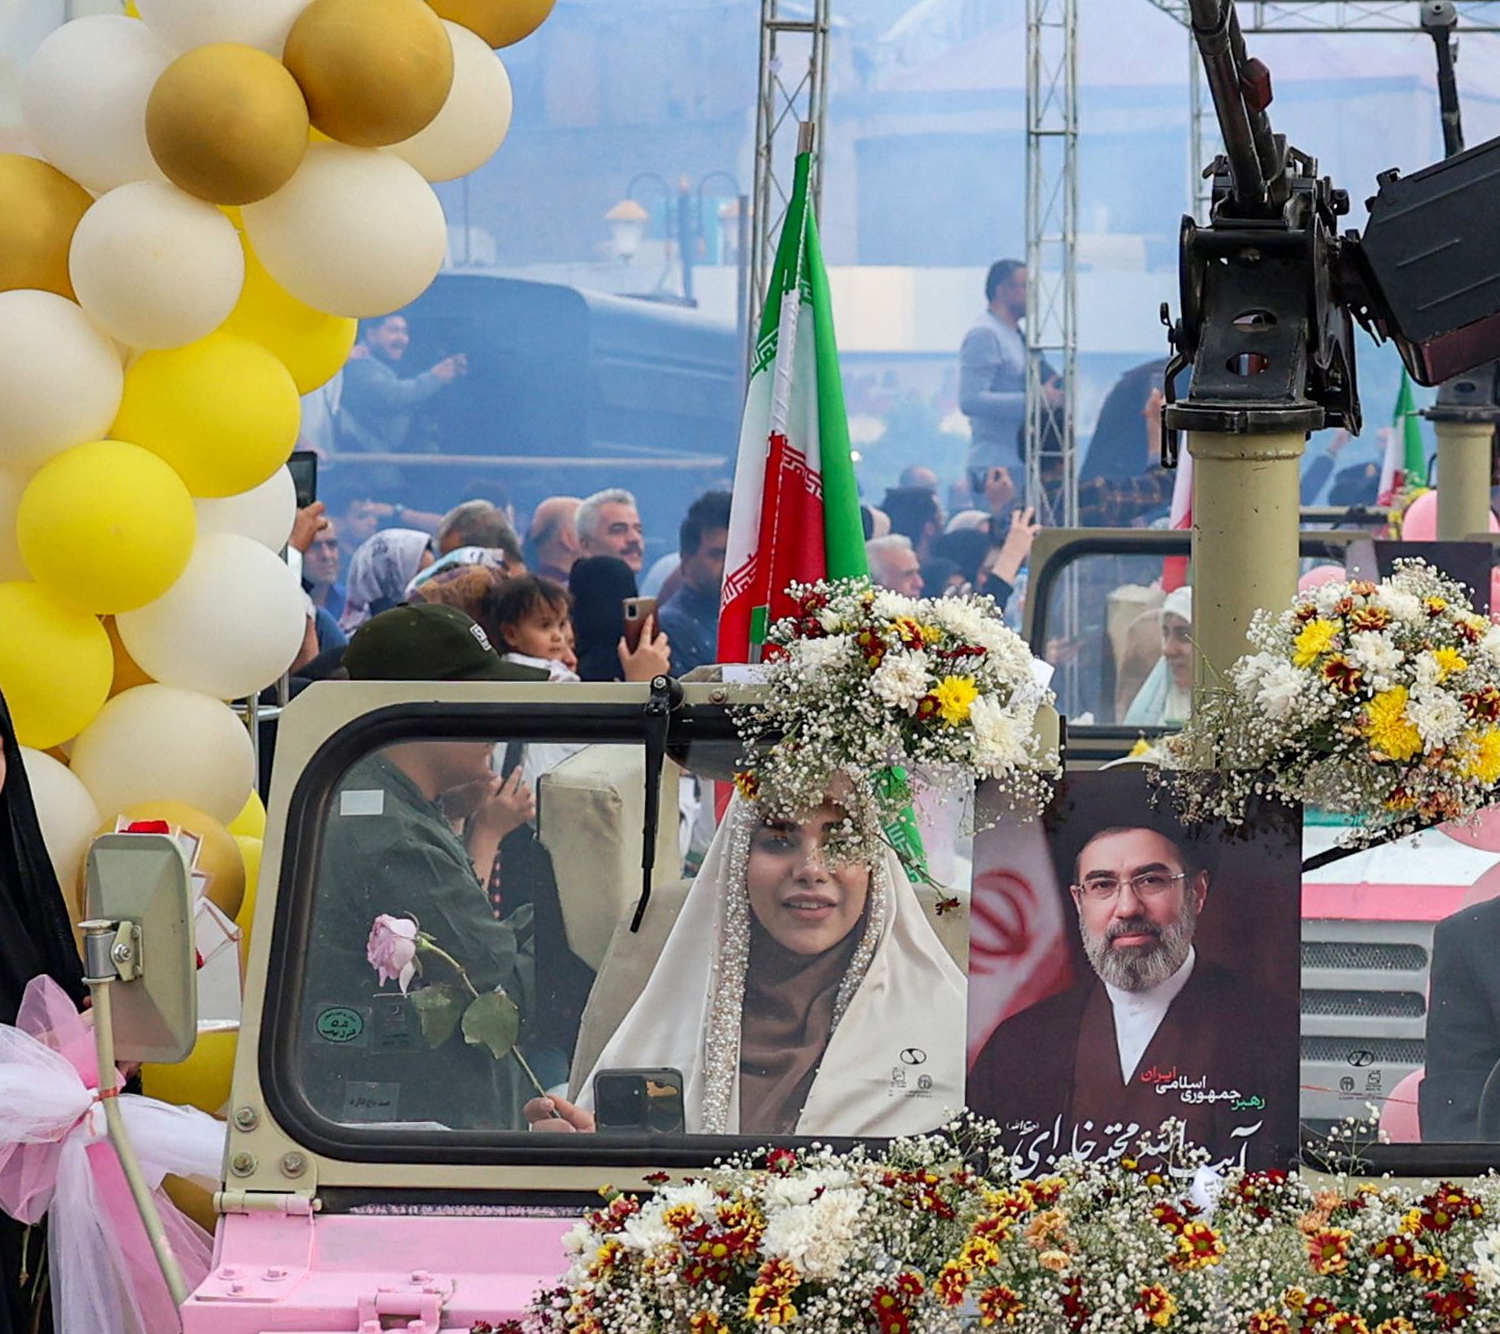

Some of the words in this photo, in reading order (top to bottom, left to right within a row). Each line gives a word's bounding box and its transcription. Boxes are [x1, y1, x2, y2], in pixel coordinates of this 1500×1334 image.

[1141, 1066, 1177, 1082] ایران
[1156, 1075, 1207, 1095] اسلامی
[1180, 1088, 1242, 1104] جمهوری
[1231, 1096, 1266, 1110] رهبر
